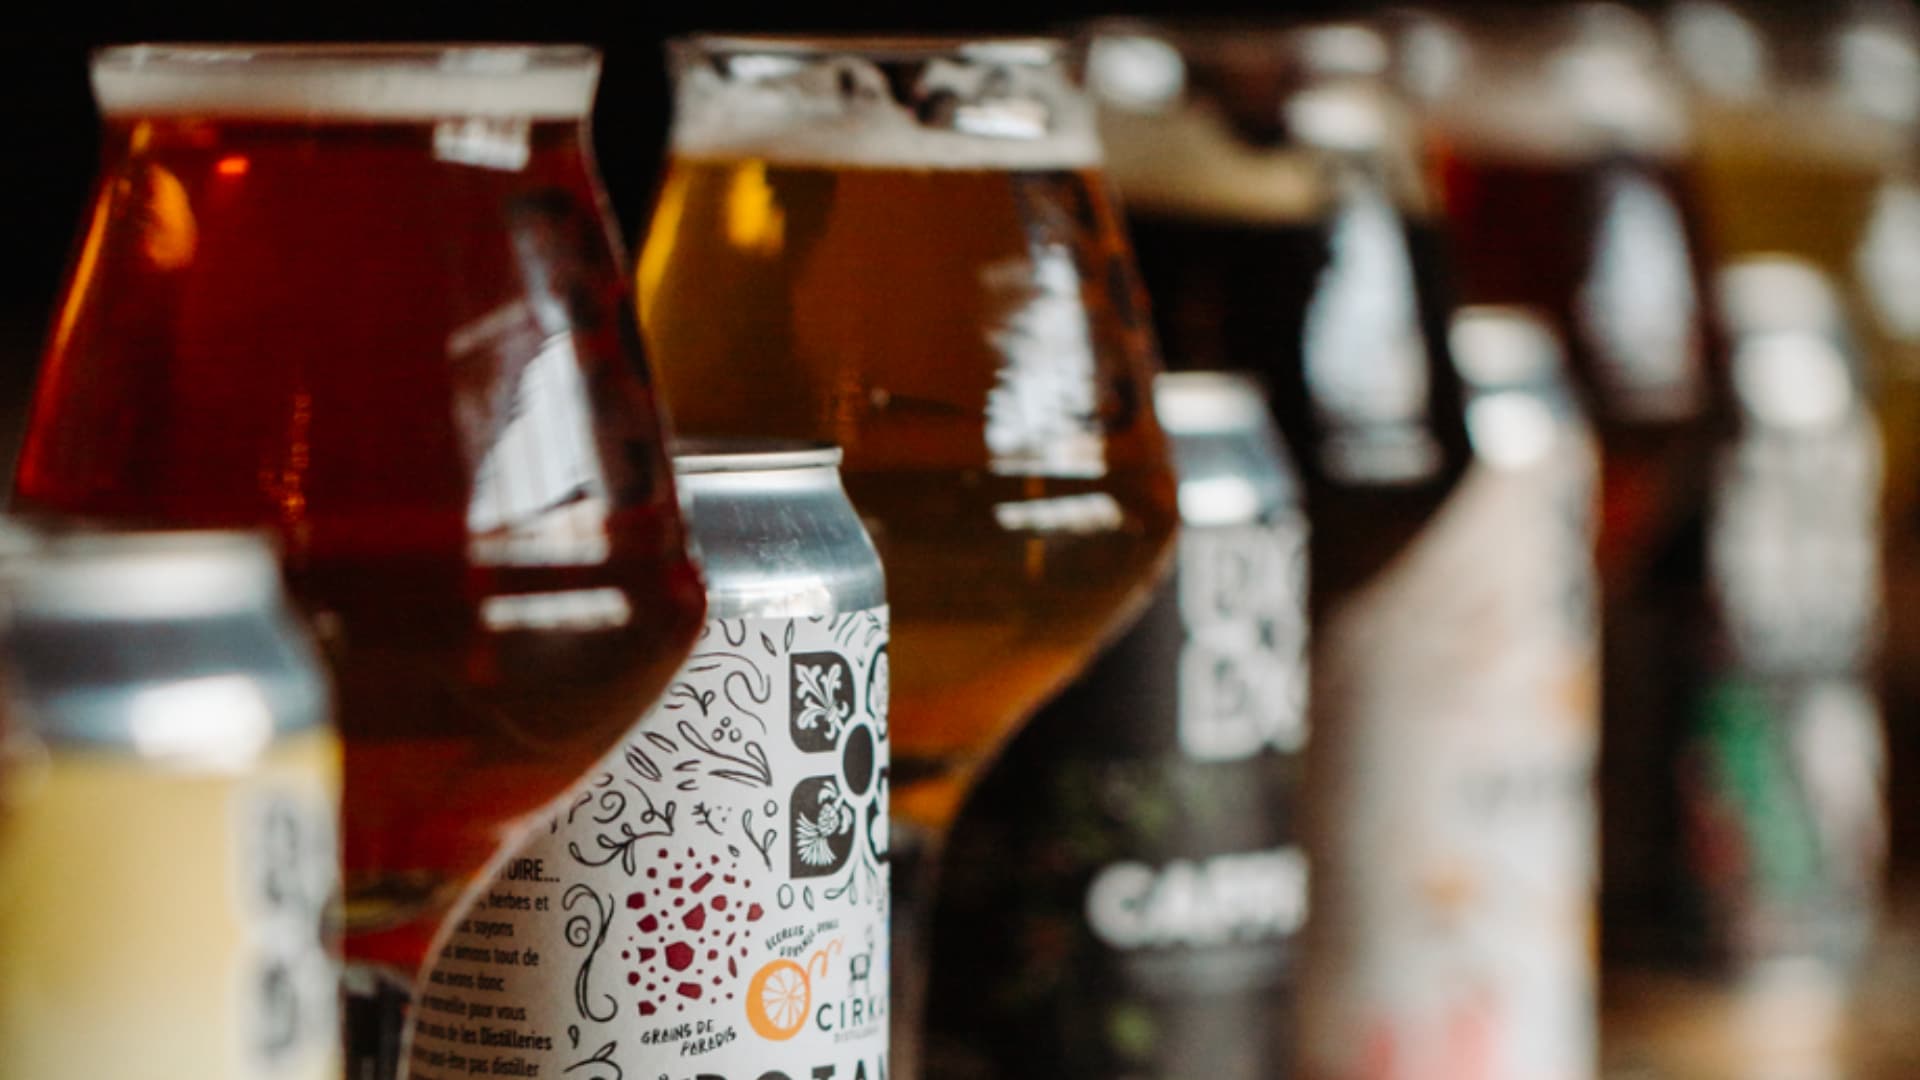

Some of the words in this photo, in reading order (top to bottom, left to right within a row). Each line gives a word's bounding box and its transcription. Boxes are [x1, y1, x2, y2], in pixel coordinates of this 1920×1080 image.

[535, 895, 549, 911] et
[494, 948, 519, 965] tout
[523, 945, 539, 966] de
[496, 1005, 526, 1021] vous
[480, 1025, 553, 1051] Distilleries
[640, 1022, 692, 1046] GRAINS
[696, 1019, 714, 1036] DE
[680, 1025, 737, 1056] PARADIS
[492, 1055, 541, 1077] distiller
